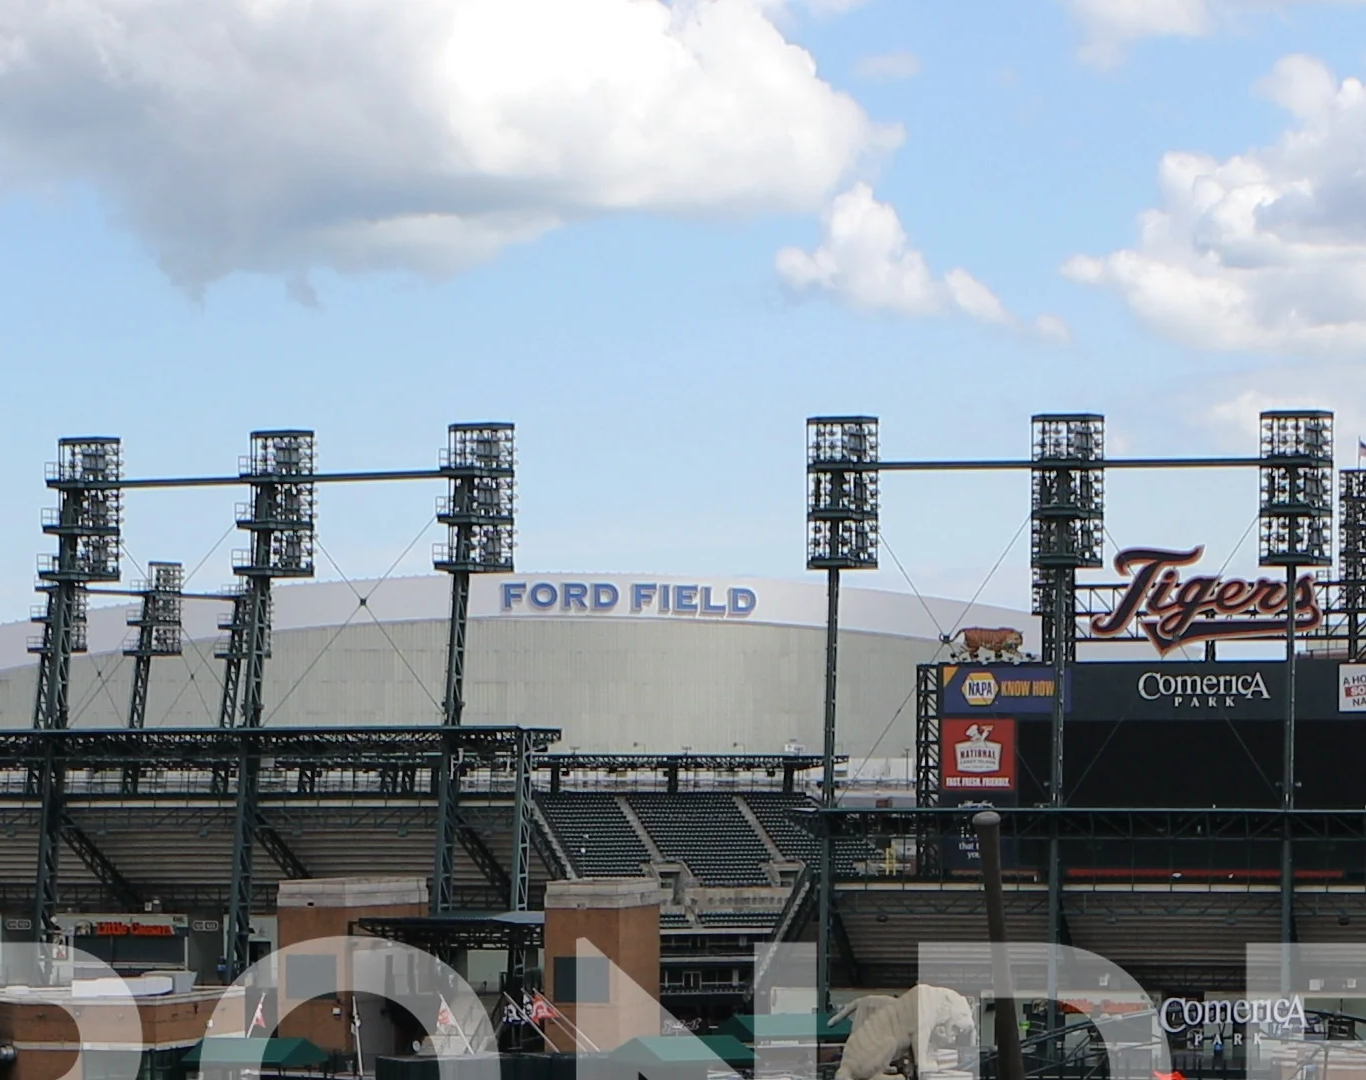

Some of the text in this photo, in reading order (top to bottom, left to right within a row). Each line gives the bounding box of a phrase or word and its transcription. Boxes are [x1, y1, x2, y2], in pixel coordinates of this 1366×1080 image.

[501, 582, 756, 616] FORD FIELD
[1090, 544, 1322, 657] Tigers
[1343, 677, 1350, 685] A
[968, 681, 1055, 696] NAPA KNOW HOW
[1174, 697, 1235, 707] PARK
[1194, 1033, 1264, 1046] PARK
